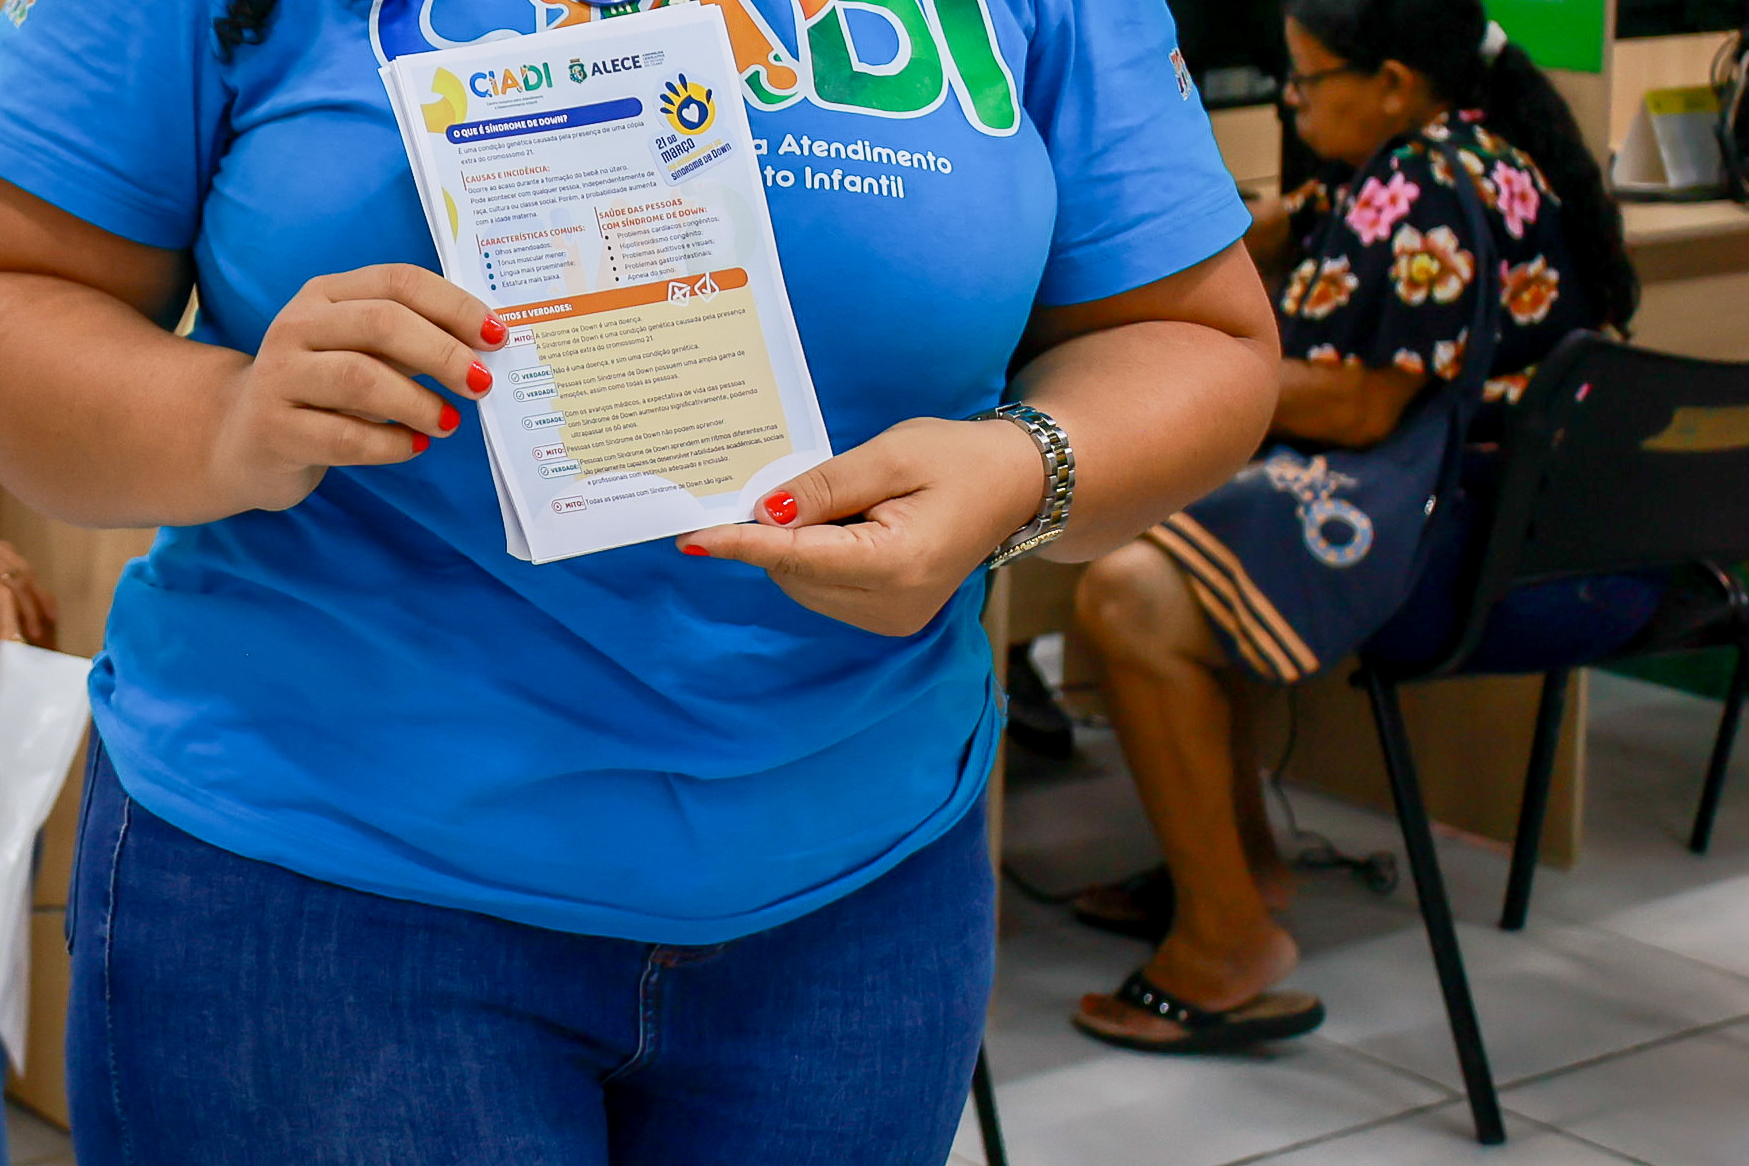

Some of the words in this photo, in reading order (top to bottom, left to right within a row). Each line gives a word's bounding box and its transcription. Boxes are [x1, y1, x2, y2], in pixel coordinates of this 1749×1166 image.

[591, 54, 642, 76] ALECE
[469, 62, 553, 98] CIADI
[452, 130, 461, 138] O
[460, 127, 479, 137] QUE
[477, 125, 485, 135] É
[484, 120, 527, 134] SÍNDROME
[526, 119, 539, 128] DE
[538, 114, 569, 126] DOWN?
[655, 136, 667, 150] 21
[778, 133, 954, 175] Atendimento
[464, 173, 497, 183] CAUSAS
[503, 165, 551, 178] INCIDÊNCIA:
[764, 165, 796, 188] to
[804, 165, 905, 199] Infantil
[598, 208, 627, 219] SAÚDE
[626, 205, 645, 214] DAS
[645, 198, 683, 211] PESSOAS
[601, 221, 621, 230] COM
[620, 214, 665, 227] SÍNDROME
[665, 211, 678, 219] DE
[677, 206, 707, 217] DOWN:
[480, 230, 549, 247] CARACTERÍSTICAS
[549, 224, 586, 236] COMUNS:
[500, 310, 521, 322] ITOS
[521, 310, 529, 319] E
[527, 303, 573, 318] VERDADES:
[513, 334, 533, 342] MITO:
[521, 370, 552, 380] VERDADE:
[526, 388, 557, 398] VERDADE:
[534, 416, 565, 426] VERDADE:
[545, 447, 565, 455] MITO:
[550, 463, 581, 473] VERDADE:
[565, 500, 584, 508] MITO:
